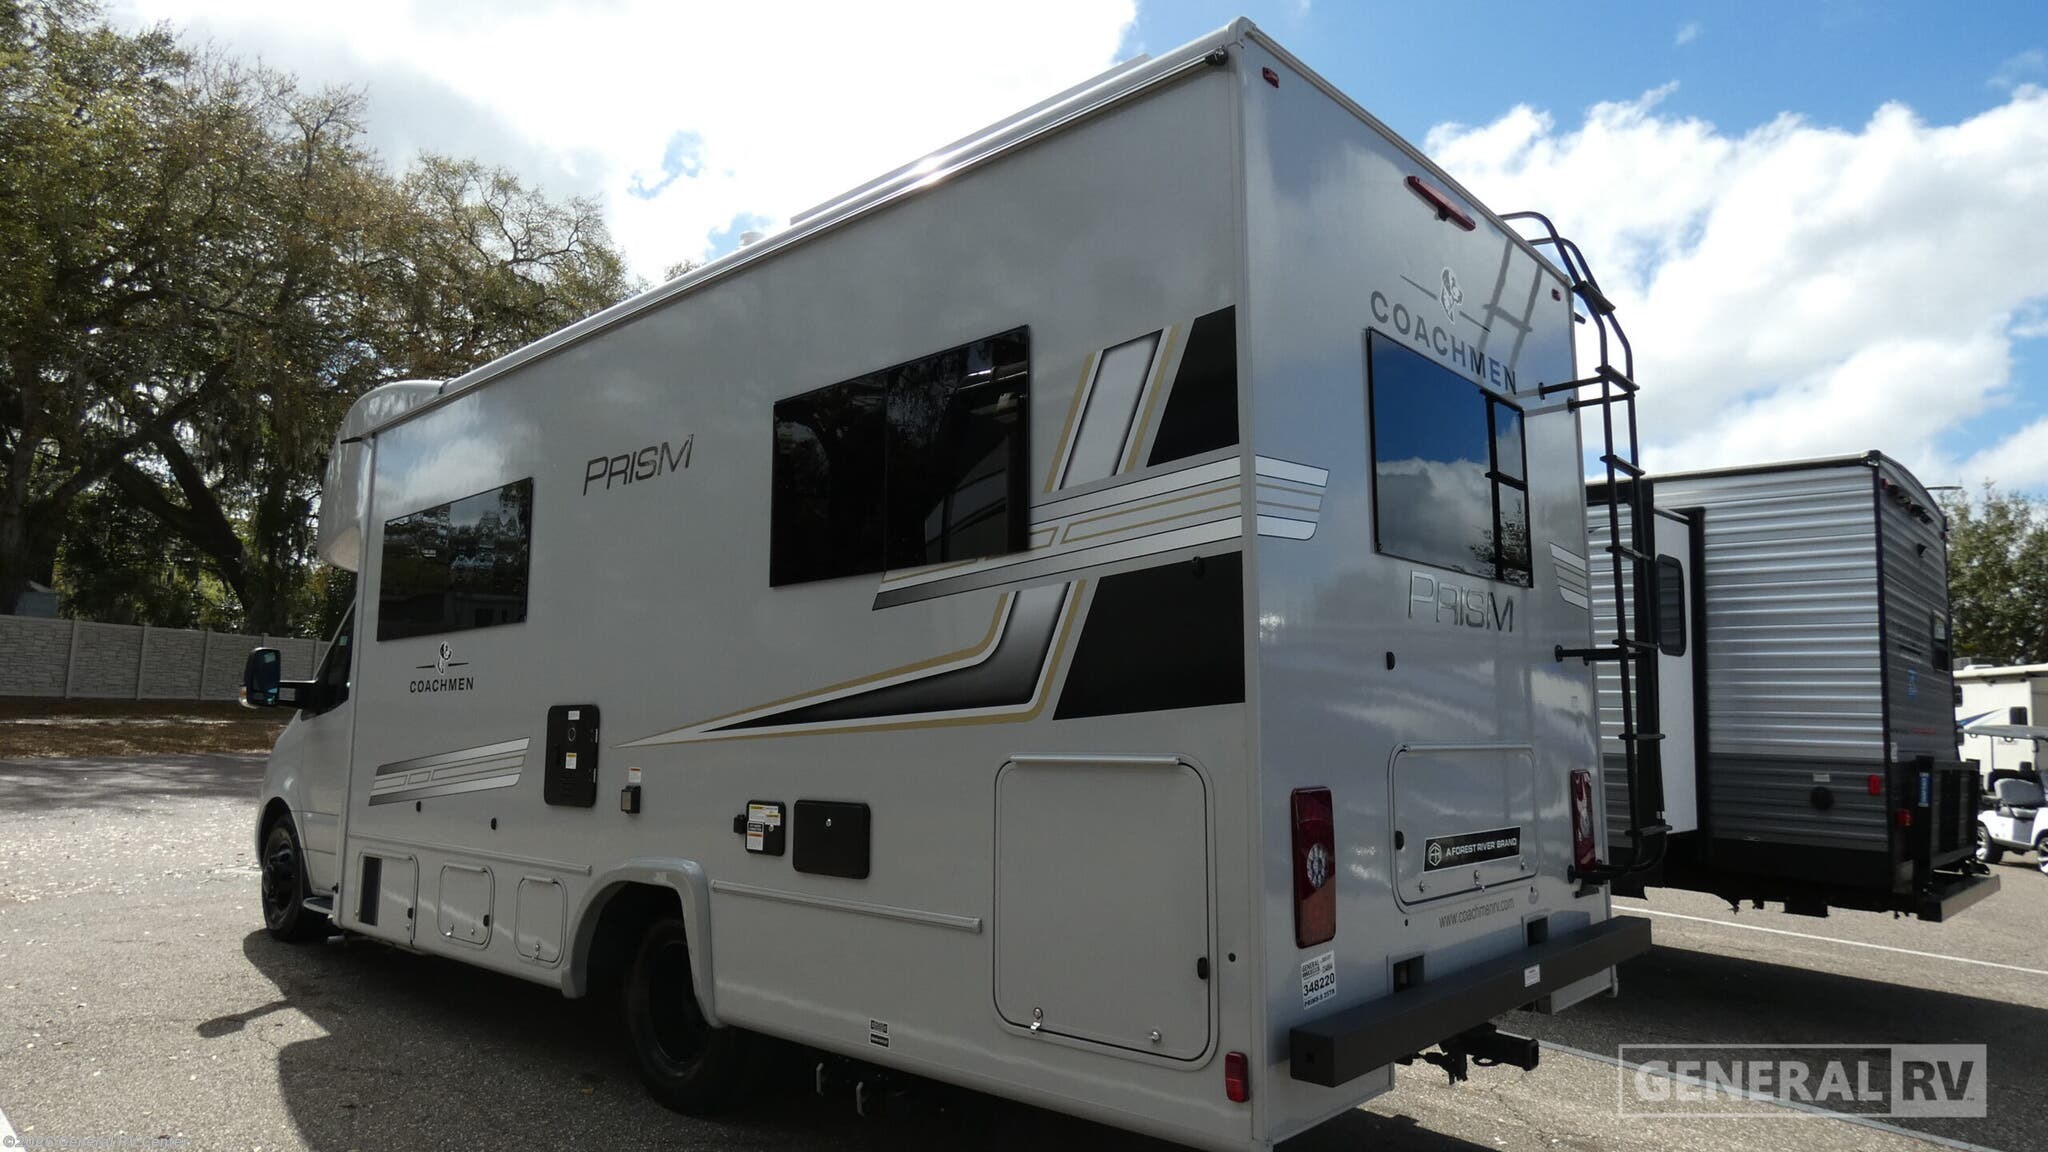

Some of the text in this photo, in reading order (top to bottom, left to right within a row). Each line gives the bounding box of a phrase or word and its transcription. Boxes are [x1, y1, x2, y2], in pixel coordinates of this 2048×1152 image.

[1370, 290, 1517, 395] COACHMEN
[583, 434, 694, 496] PRISM
[1408, 570, 1513, 632] PRISM
[409, 677, 474, 693] COACHMEN
[1452, 845, 1476, 855] FOREST
[1477, 842, 1495, 851] RIVER
[1496, 838, 1517, 848] BRAND
[1438, 898, 1515, 928] www.coachmenrv.com
[1303, 972, 1335, 996] 348220
